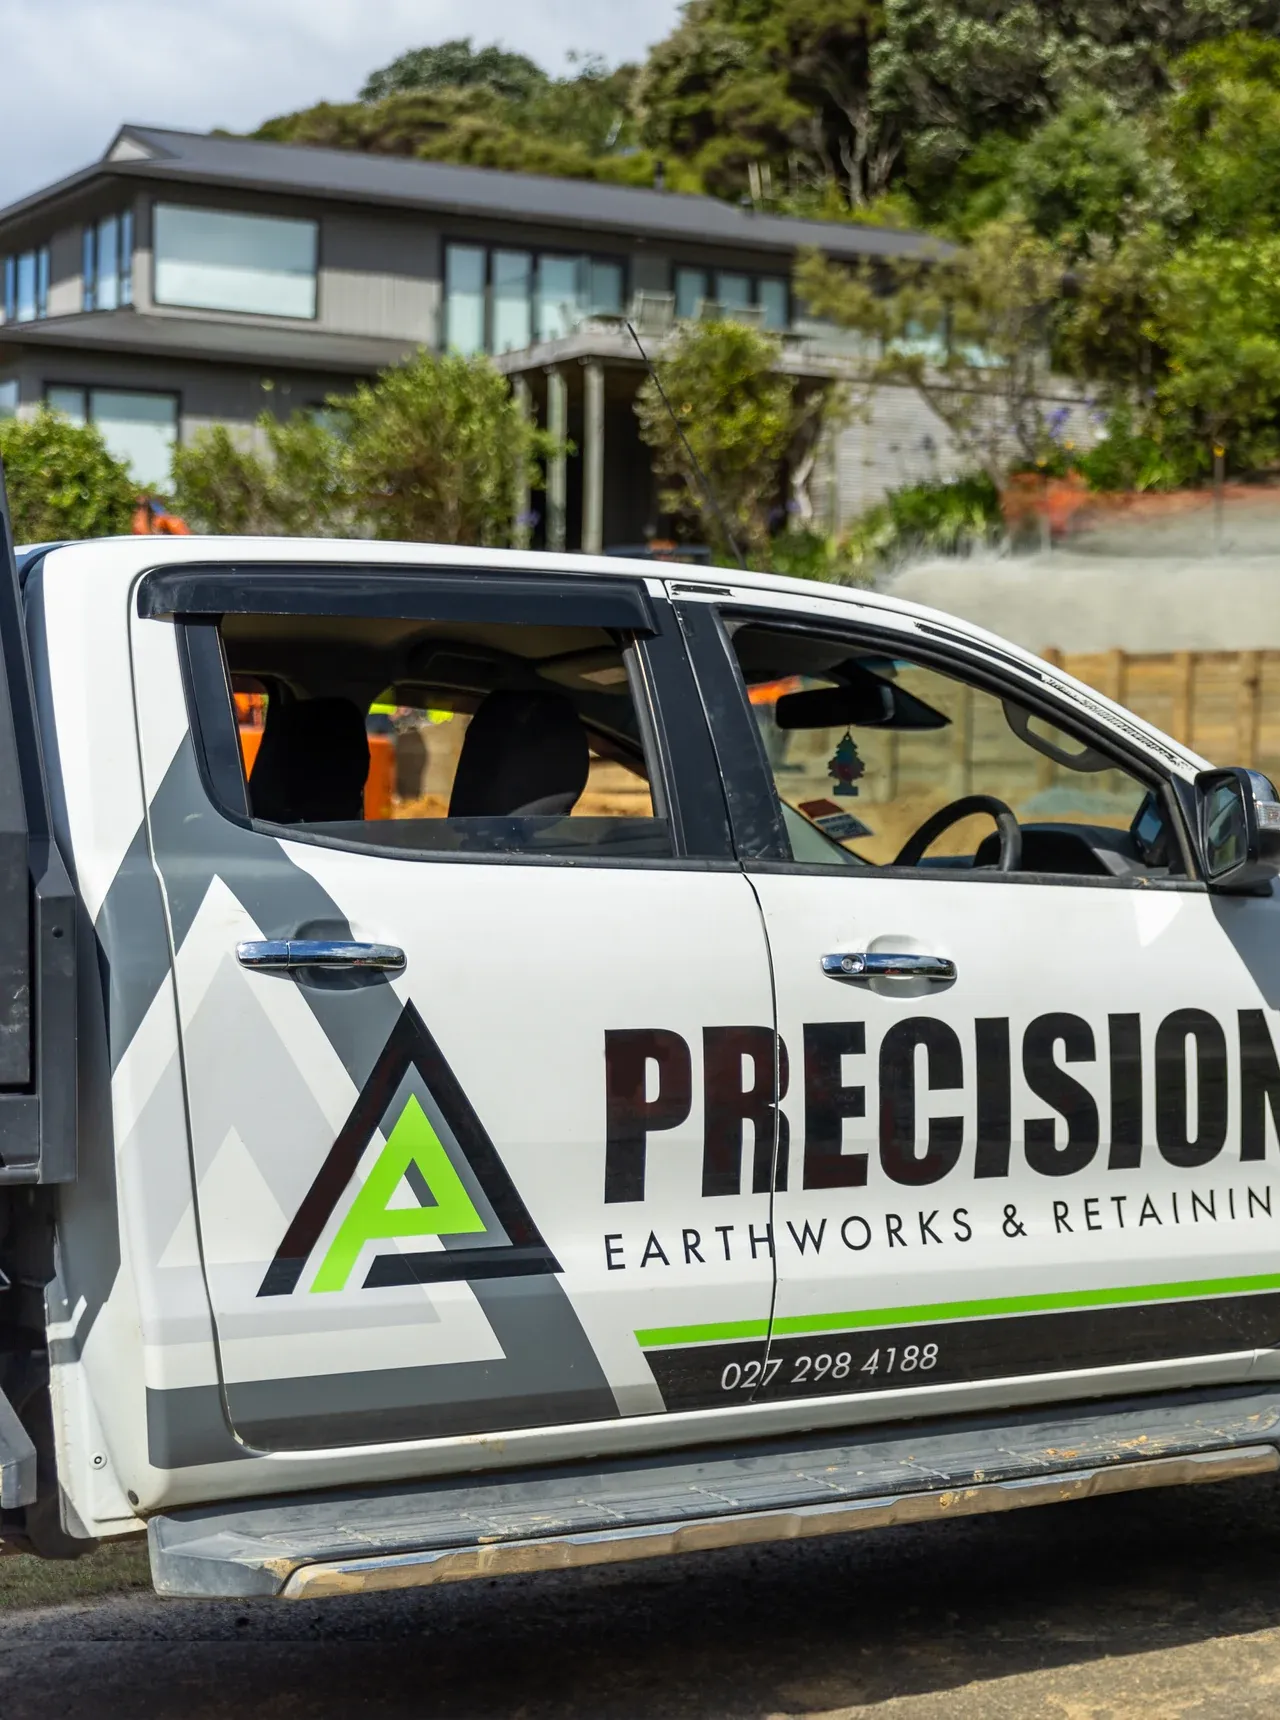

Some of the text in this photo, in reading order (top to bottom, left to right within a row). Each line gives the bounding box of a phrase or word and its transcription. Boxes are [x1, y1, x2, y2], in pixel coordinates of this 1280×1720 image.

[605, 1207, 974, 1271] EARTHWORKS
[1002, 1203, 1028, 1239] &
[720, 1343, 940, 1392] 027 298 4188
